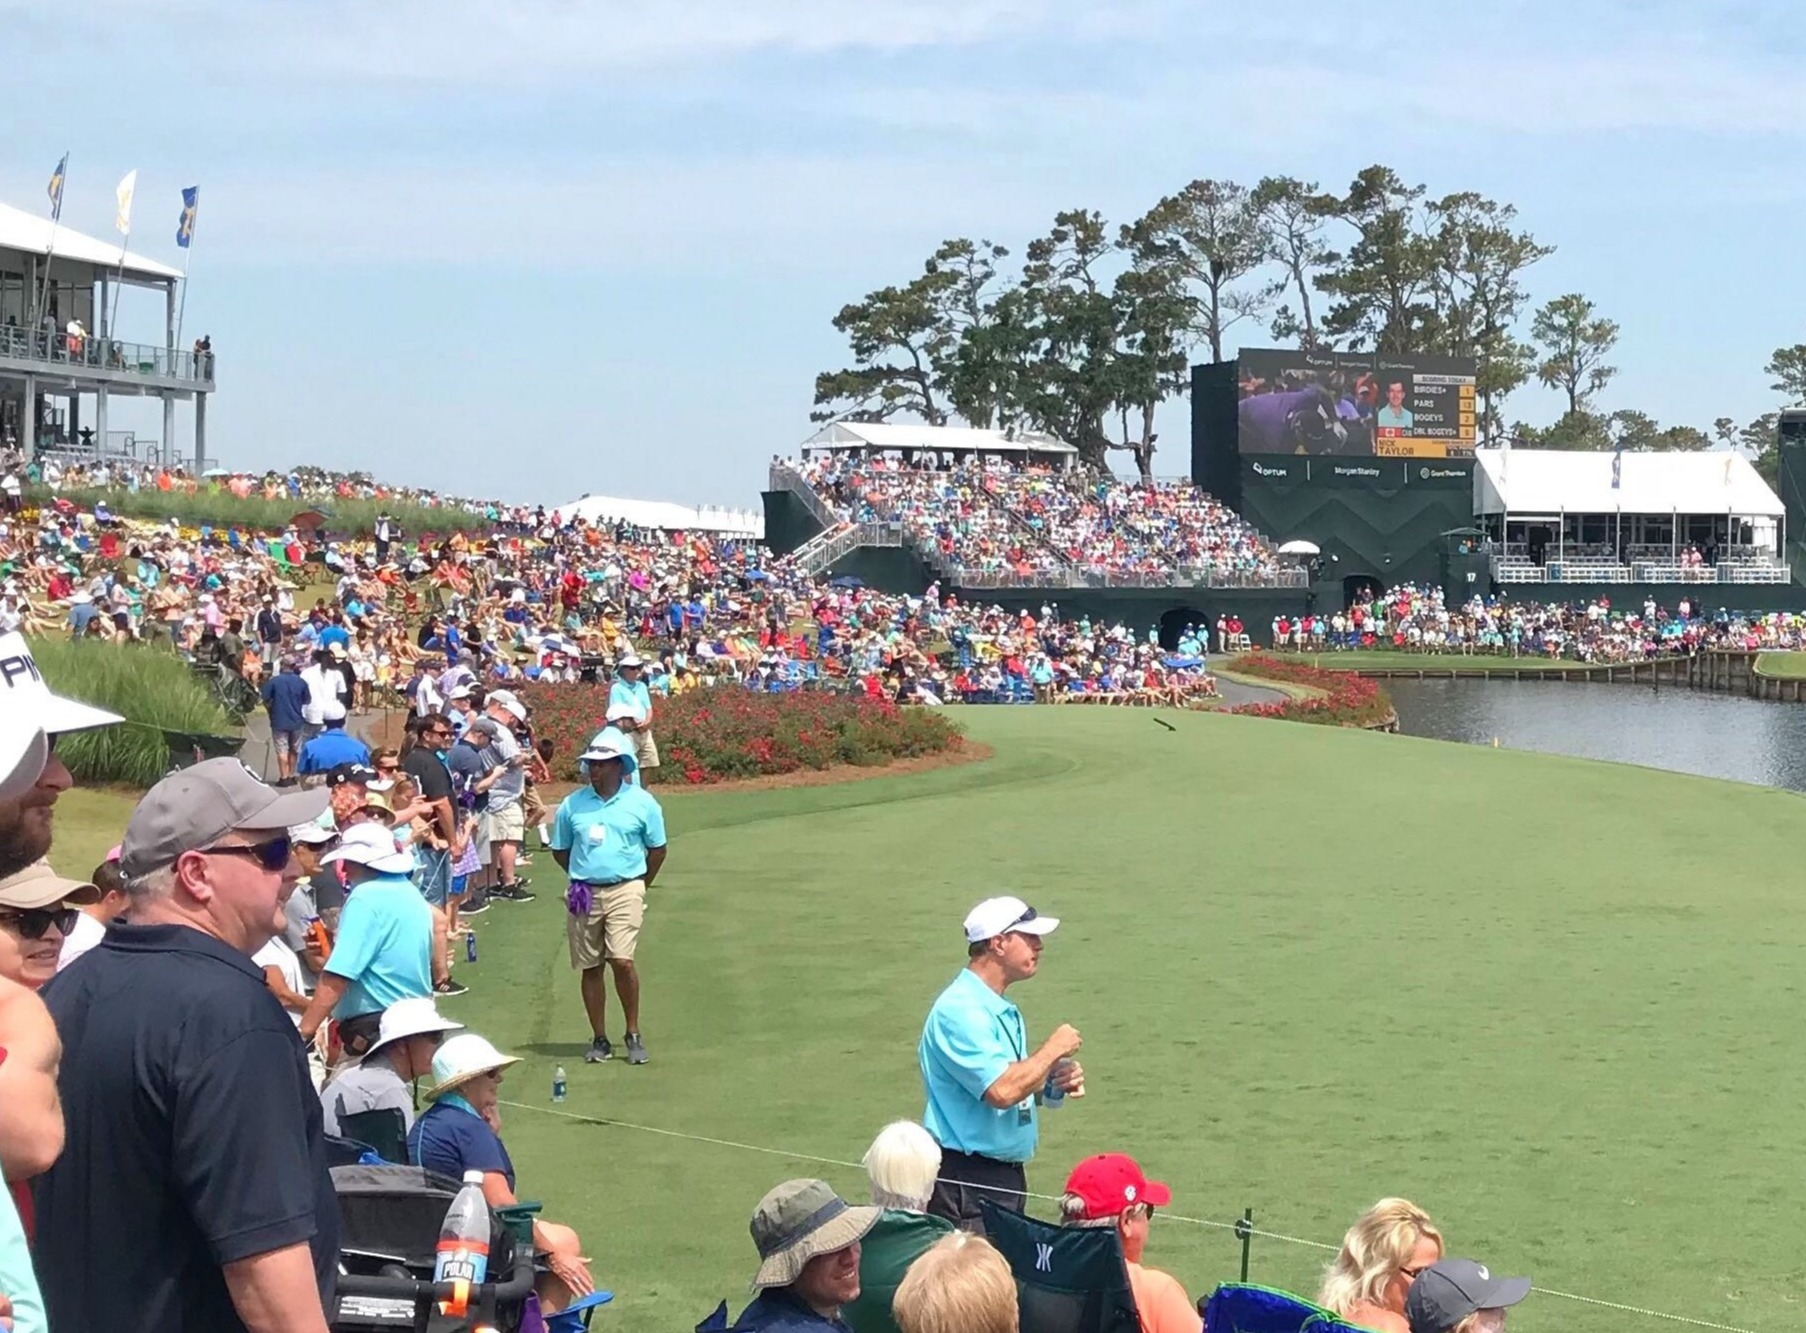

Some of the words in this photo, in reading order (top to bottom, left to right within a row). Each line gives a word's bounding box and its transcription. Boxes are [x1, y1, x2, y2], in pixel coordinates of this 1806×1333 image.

[1414, 399, 1434, 407] PARS
[1414, 413, 1444, 421] BOGEYS
[1380, 447, 1414, 455] TAYLOR
[1262, 468, 1287, 476] OPTUM
[1467, 572, 1476, 582] 17
[443, 1261, 473, 1279] POLAR
